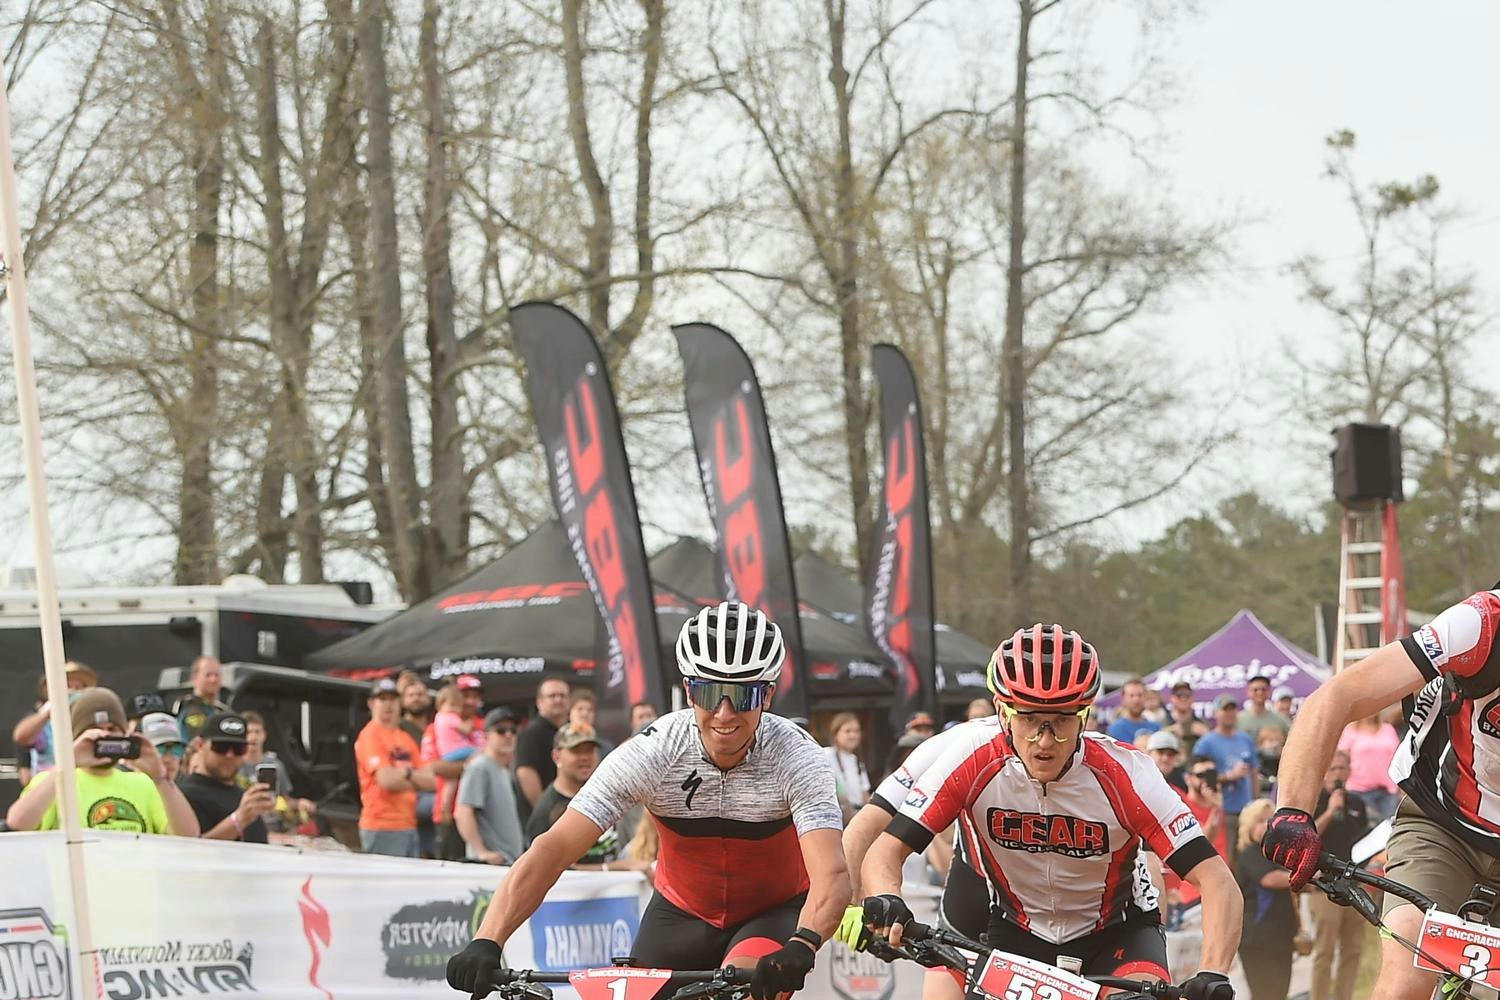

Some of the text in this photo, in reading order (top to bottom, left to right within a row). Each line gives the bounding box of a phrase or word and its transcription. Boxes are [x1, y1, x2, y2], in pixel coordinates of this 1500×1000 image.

[992, 810, 1104, 850] GEAR
[1459, 943, 1491, 981] 3
[1010, 963, 1093, 1000] GNCCRACING.COM
